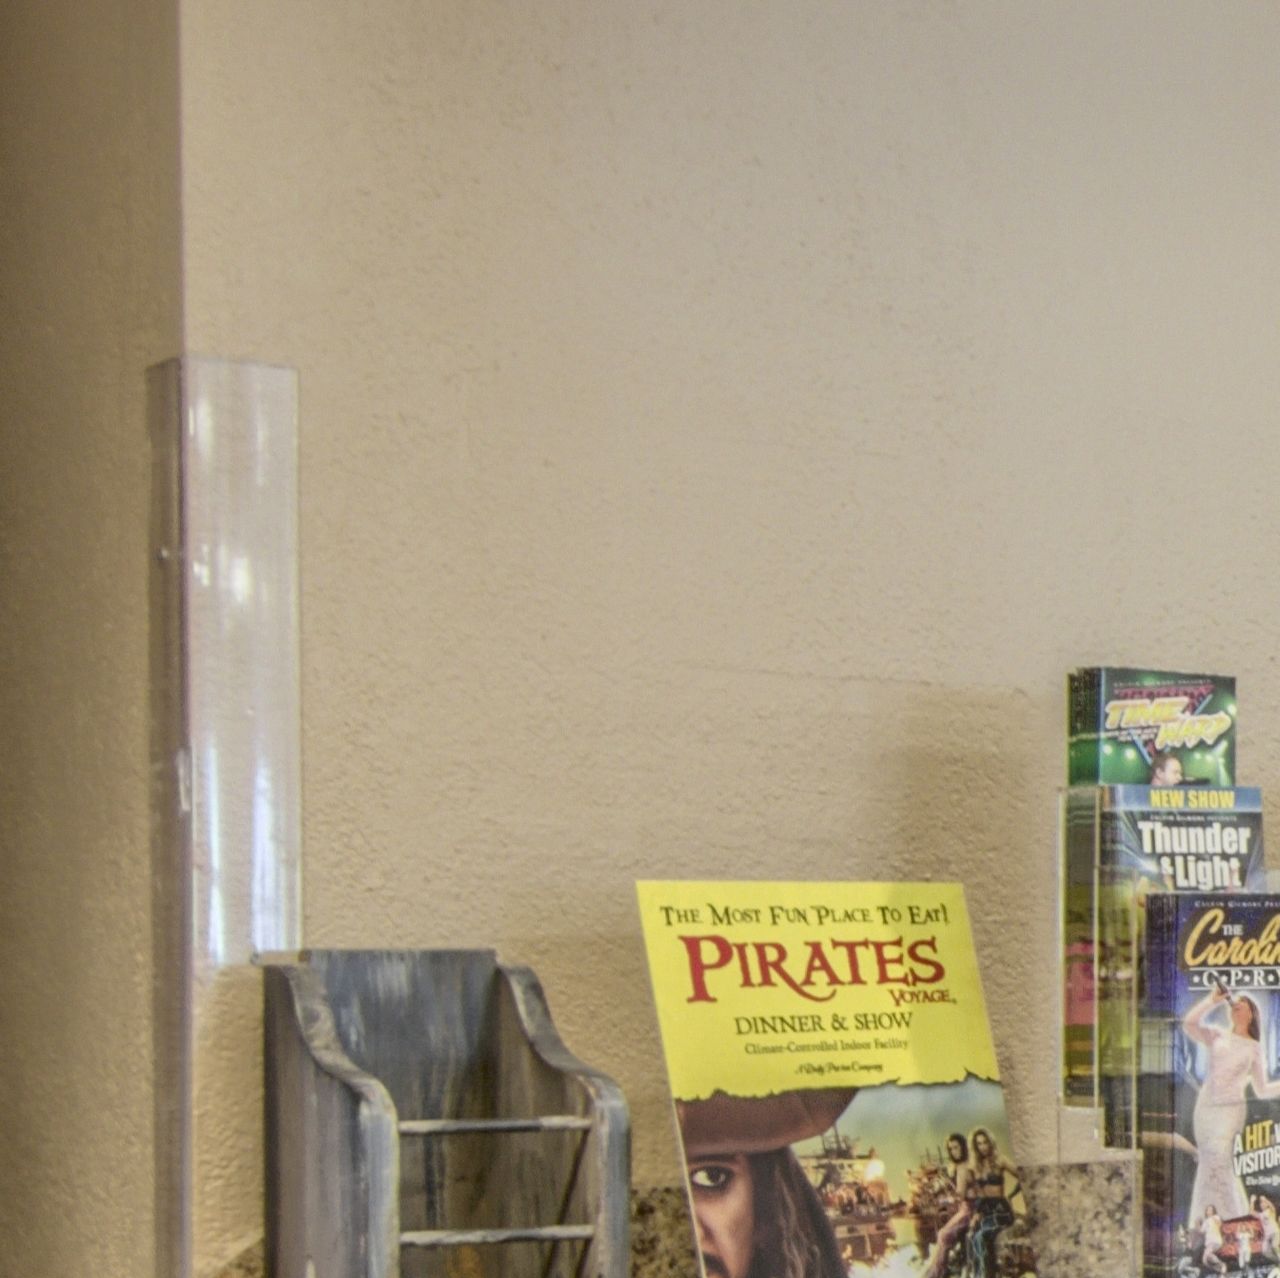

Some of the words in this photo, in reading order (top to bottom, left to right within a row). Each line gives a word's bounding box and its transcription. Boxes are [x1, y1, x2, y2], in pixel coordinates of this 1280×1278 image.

[1150, 789, 1185, 809] NEW
[1187, 789, 1236, 810] SHOW
[1137, 820, 1252, 854] Thunder
[1160, 855, 1174, 876] &
[1174, 855, 1242, 891] Light
[706, 903, 761, 926] MOST
[768, 904, 809, 926] FUN
[809, 904, 873, 925] PLACE
[876, 905, 901, 925] TO
[1222, 924, 1244, 936] THE
[677, 933, 946, 1004] PIRATES
[888, 988, 951, 1007] VOYAGE
[734, 1014, 825, 1036] DINNER
[831, 1012, 849, 1032] &
[853, 1011, 913, 1031] SHOW
[1233, 1133, 1244, 1155] A
[1245, 1119, 1273, 1152] HIT
